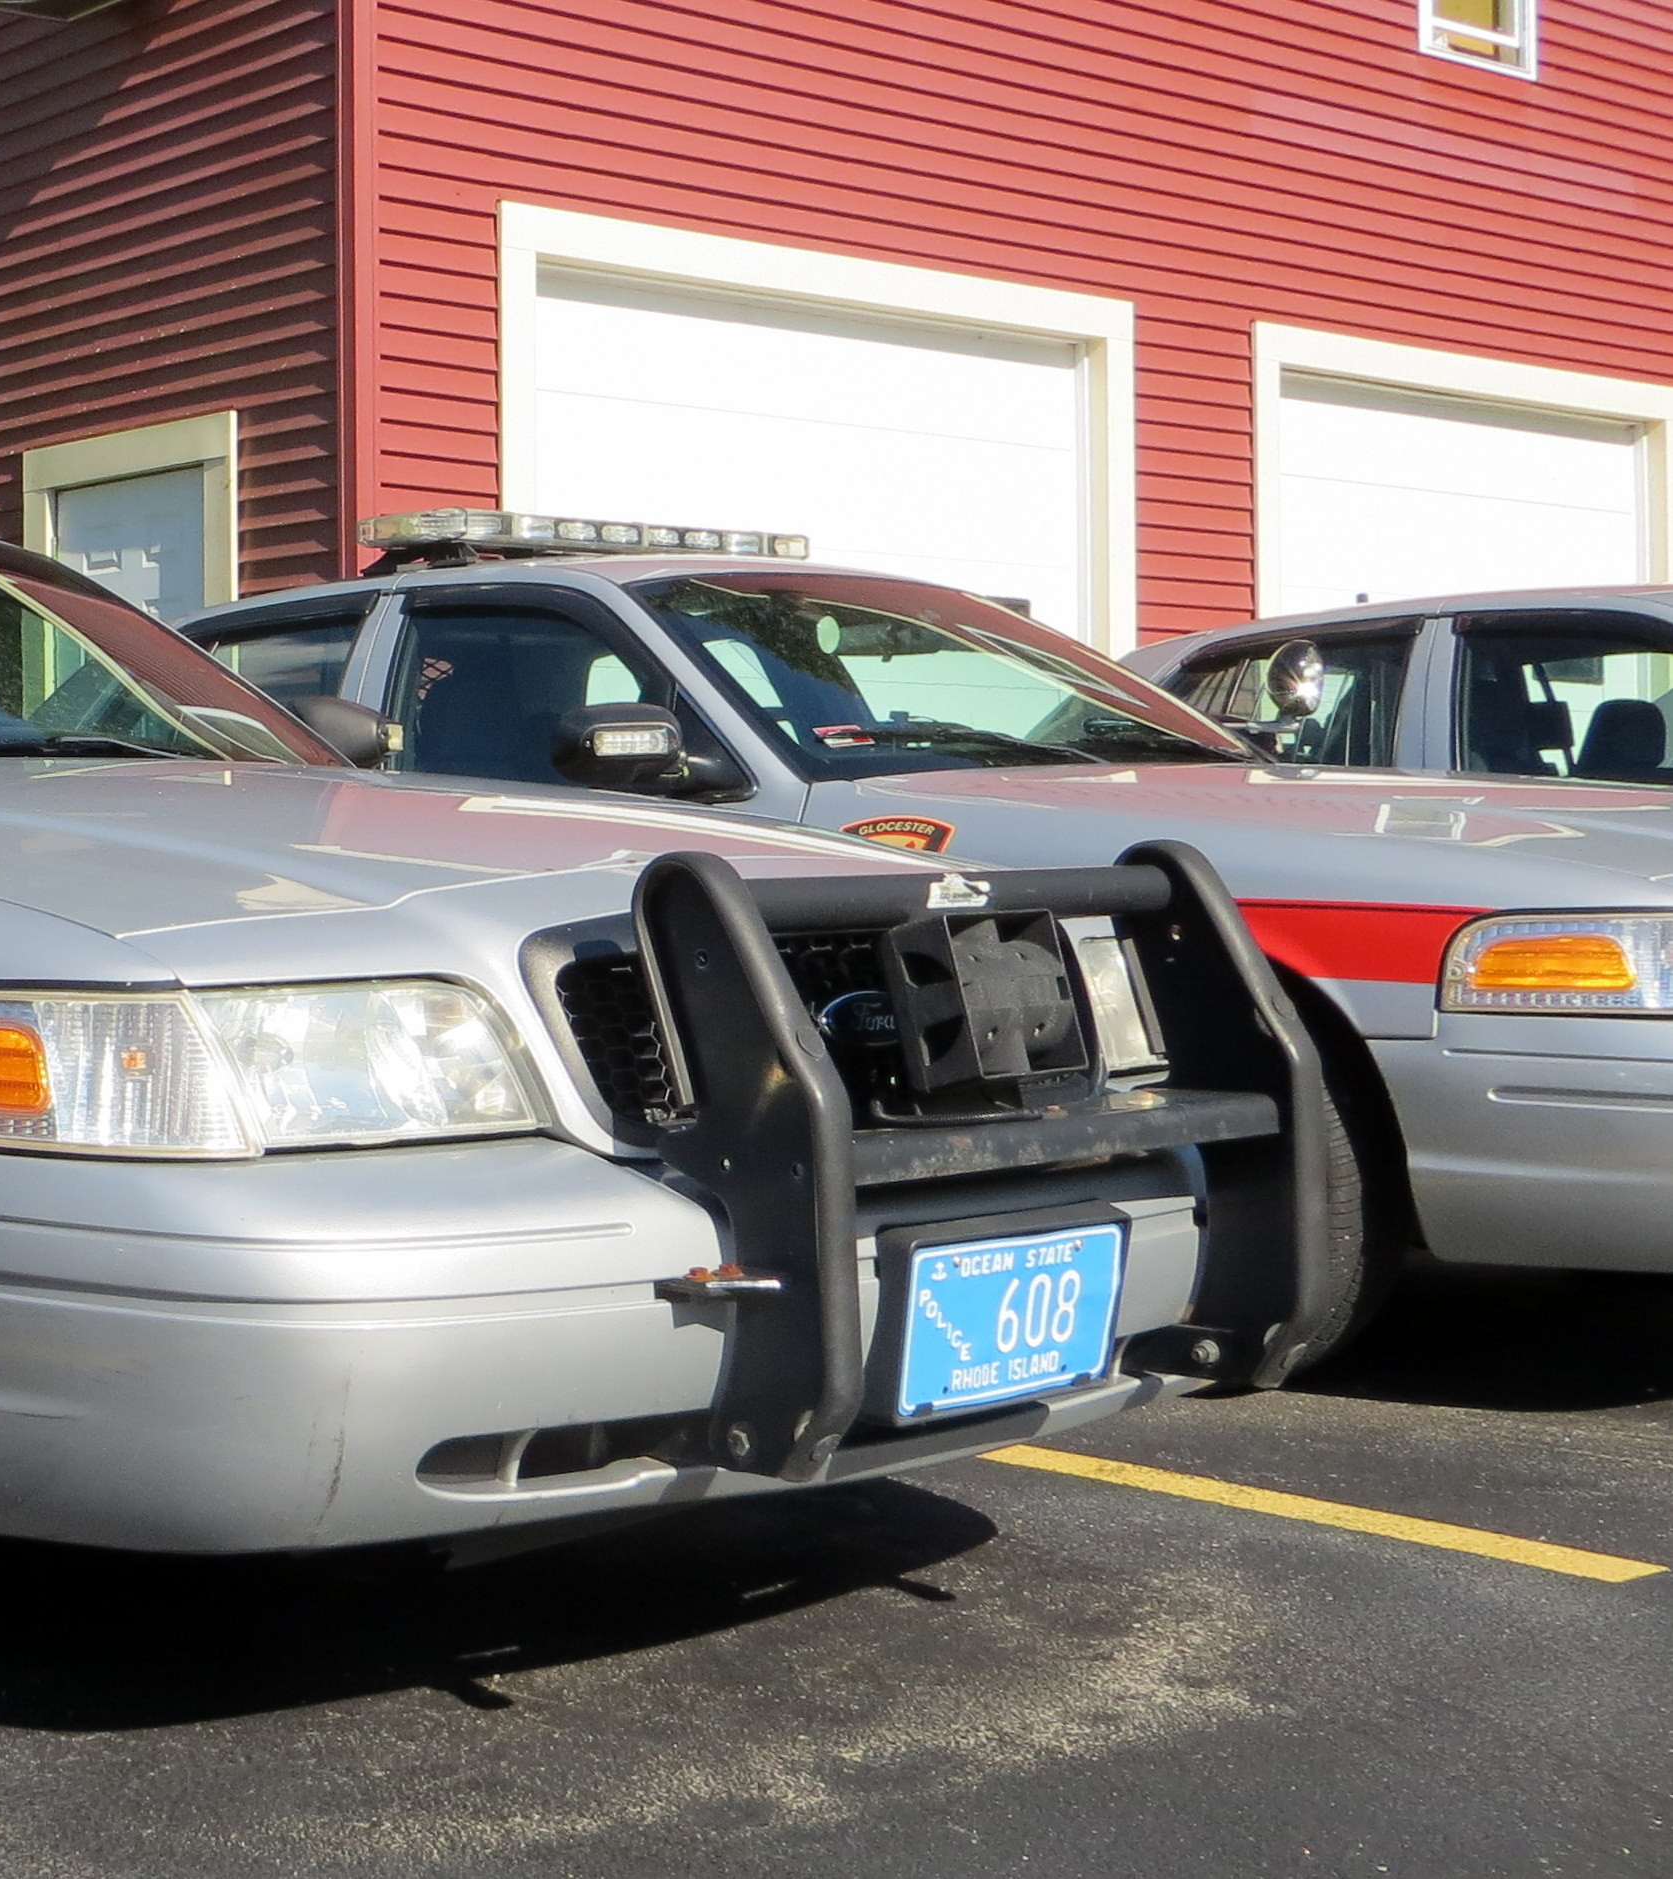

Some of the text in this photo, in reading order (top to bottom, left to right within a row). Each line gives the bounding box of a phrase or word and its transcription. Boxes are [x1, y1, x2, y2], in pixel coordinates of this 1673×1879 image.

[858, 821, 935, 836] GLOCESTER
[959, 1246, 1073, 1277] OCEAN STATE
[919, 1288, 972, 1362] POLICE
[996, 1269, 1081, 1353] 608
[950, 1350, 1060, 1392] RHODE ISLAND
